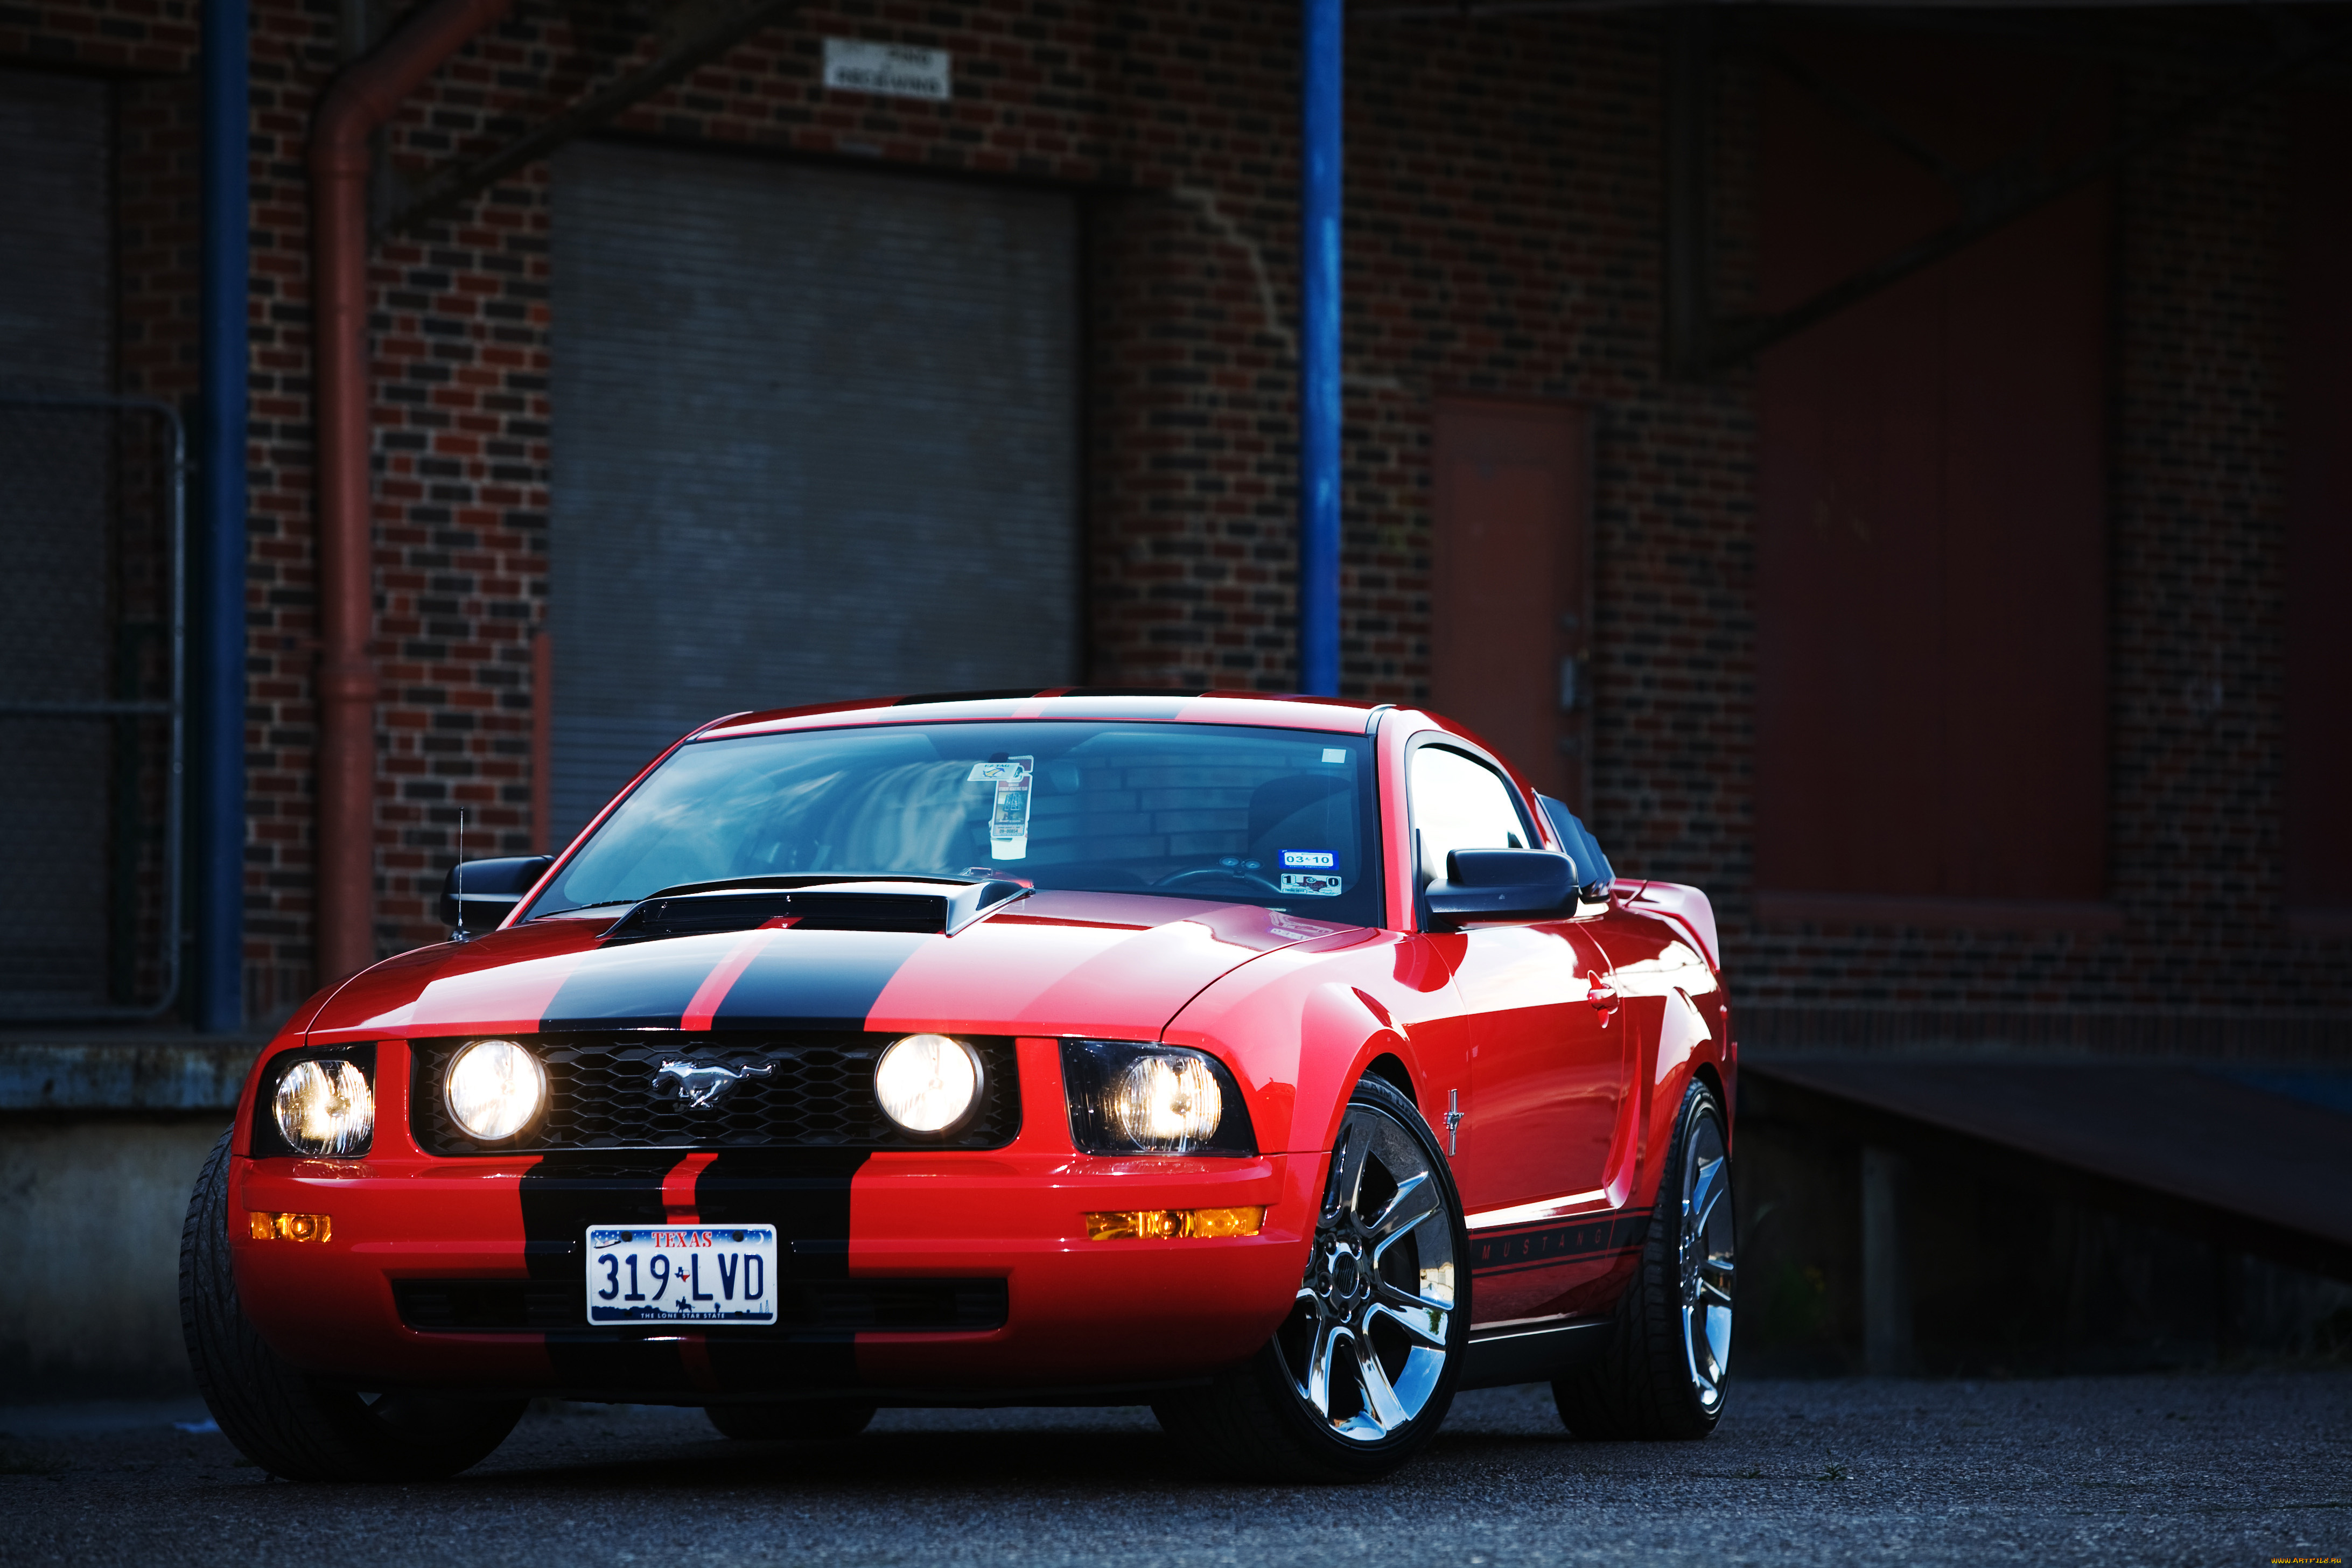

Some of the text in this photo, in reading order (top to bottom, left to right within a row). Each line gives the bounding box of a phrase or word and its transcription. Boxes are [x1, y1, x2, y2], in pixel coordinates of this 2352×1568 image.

[1284, 876, 1291, 884] 1
[1328, 878, 1339, 886] 0
[651, 1231, 712, 1248] TEXAS
[1482, 1229, 1602, 1260] MUSTANG
[598, 1253, 764, 1301] 319 LVD
